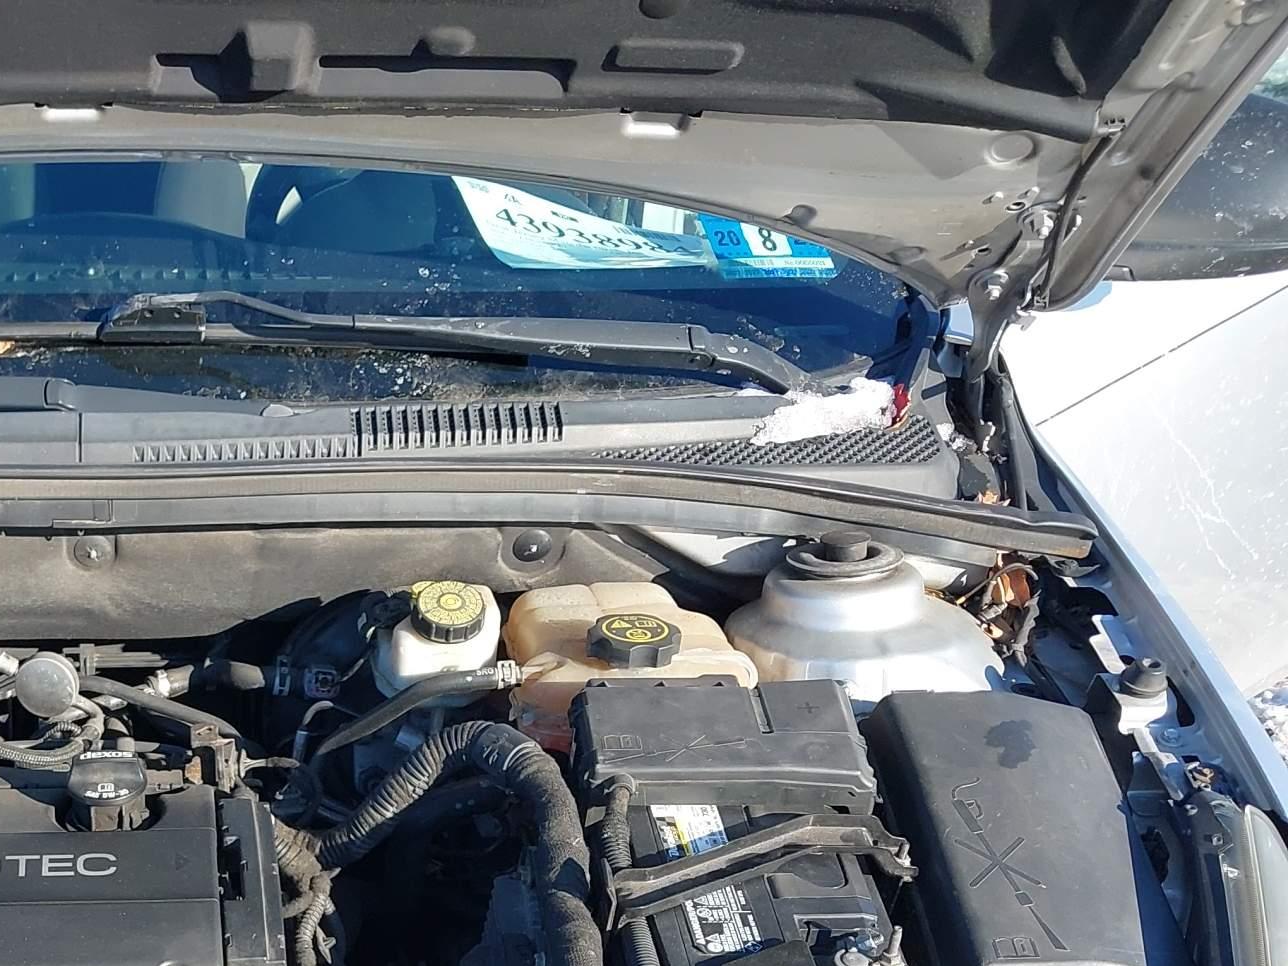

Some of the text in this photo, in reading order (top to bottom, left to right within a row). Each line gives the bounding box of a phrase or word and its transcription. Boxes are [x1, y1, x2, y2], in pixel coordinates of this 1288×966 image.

[714, 230, 741, 246] 20
[757, 227, 777, 251] 8
[79, 751, 133, 760] dexos
